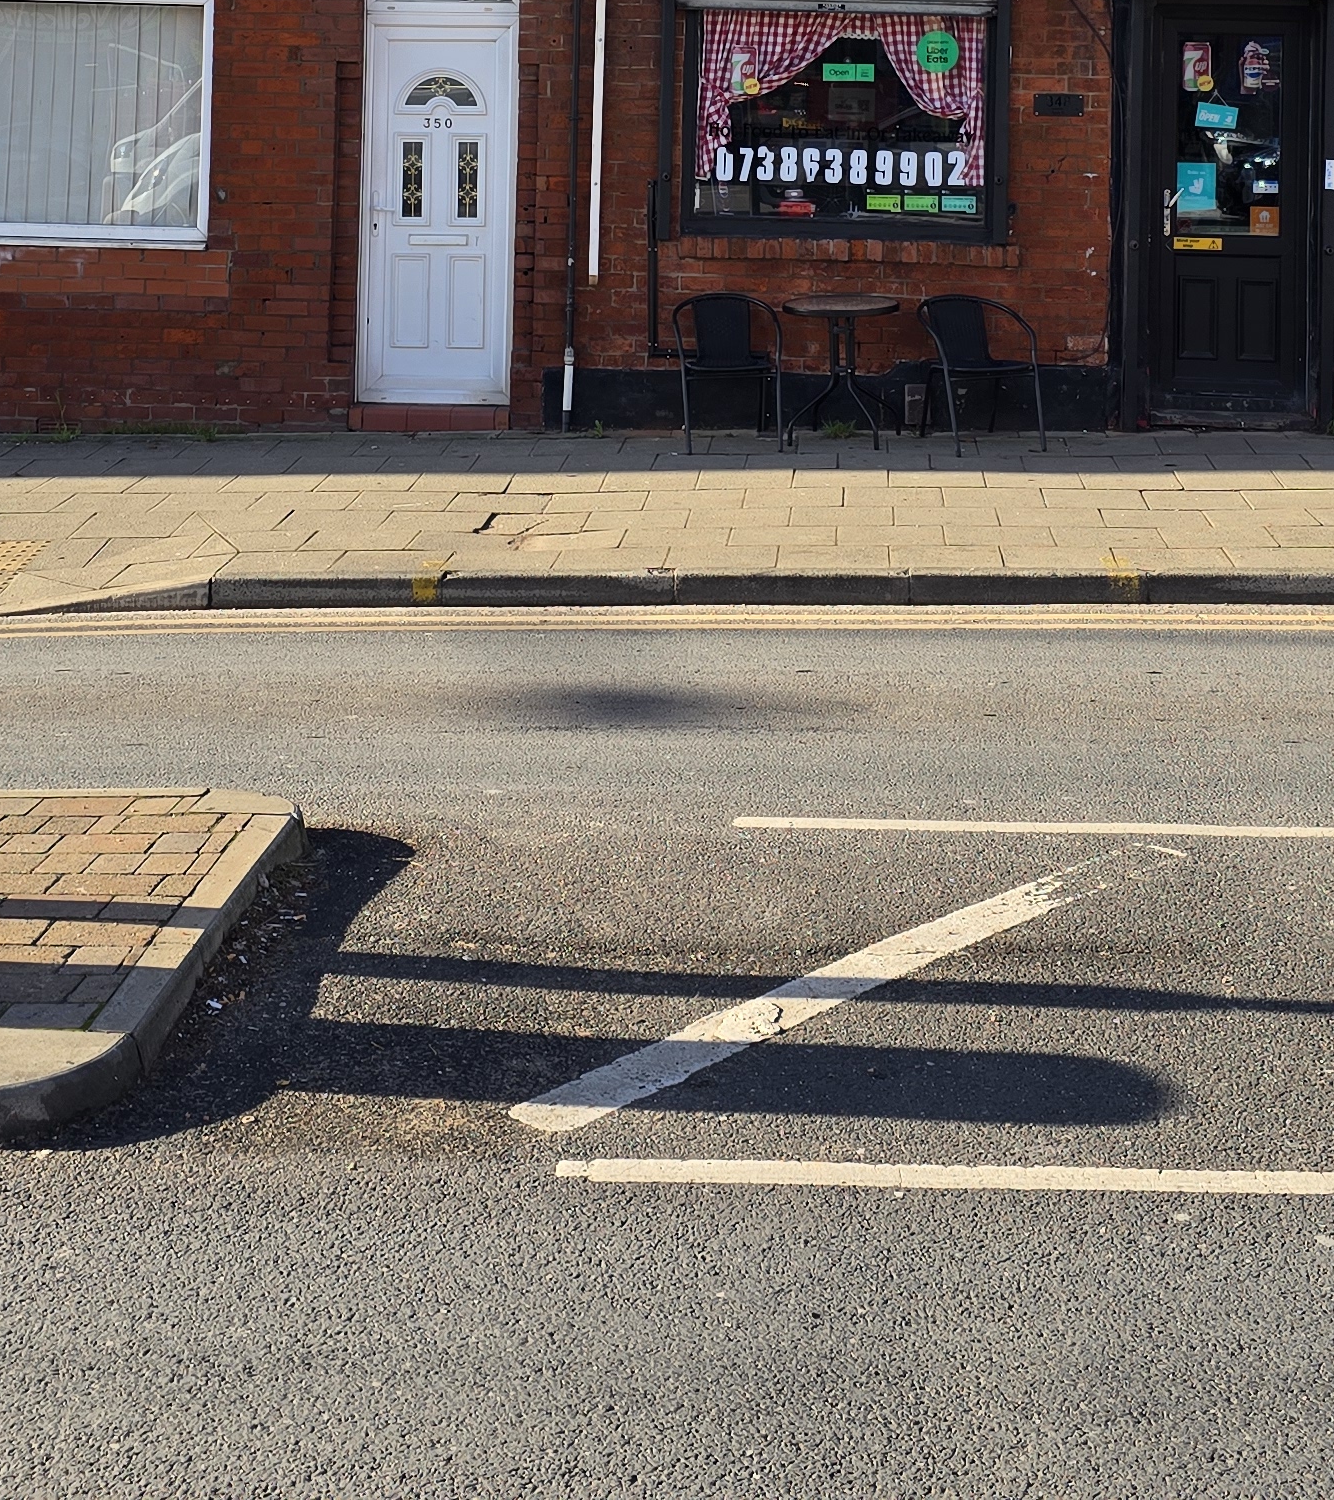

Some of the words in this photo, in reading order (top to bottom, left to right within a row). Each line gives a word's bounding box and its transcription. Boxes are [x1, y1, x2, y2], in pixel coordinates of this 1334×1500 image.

[926, 45, 948, 54] Uber
[926, 54, 948, 63] Eats
[828, 68, 849, 76] Open
[1198, 109, 1220, 123] OPEN
[423, 118, 452, 129] 350
[717, 146, 966, 186] 07386389902
